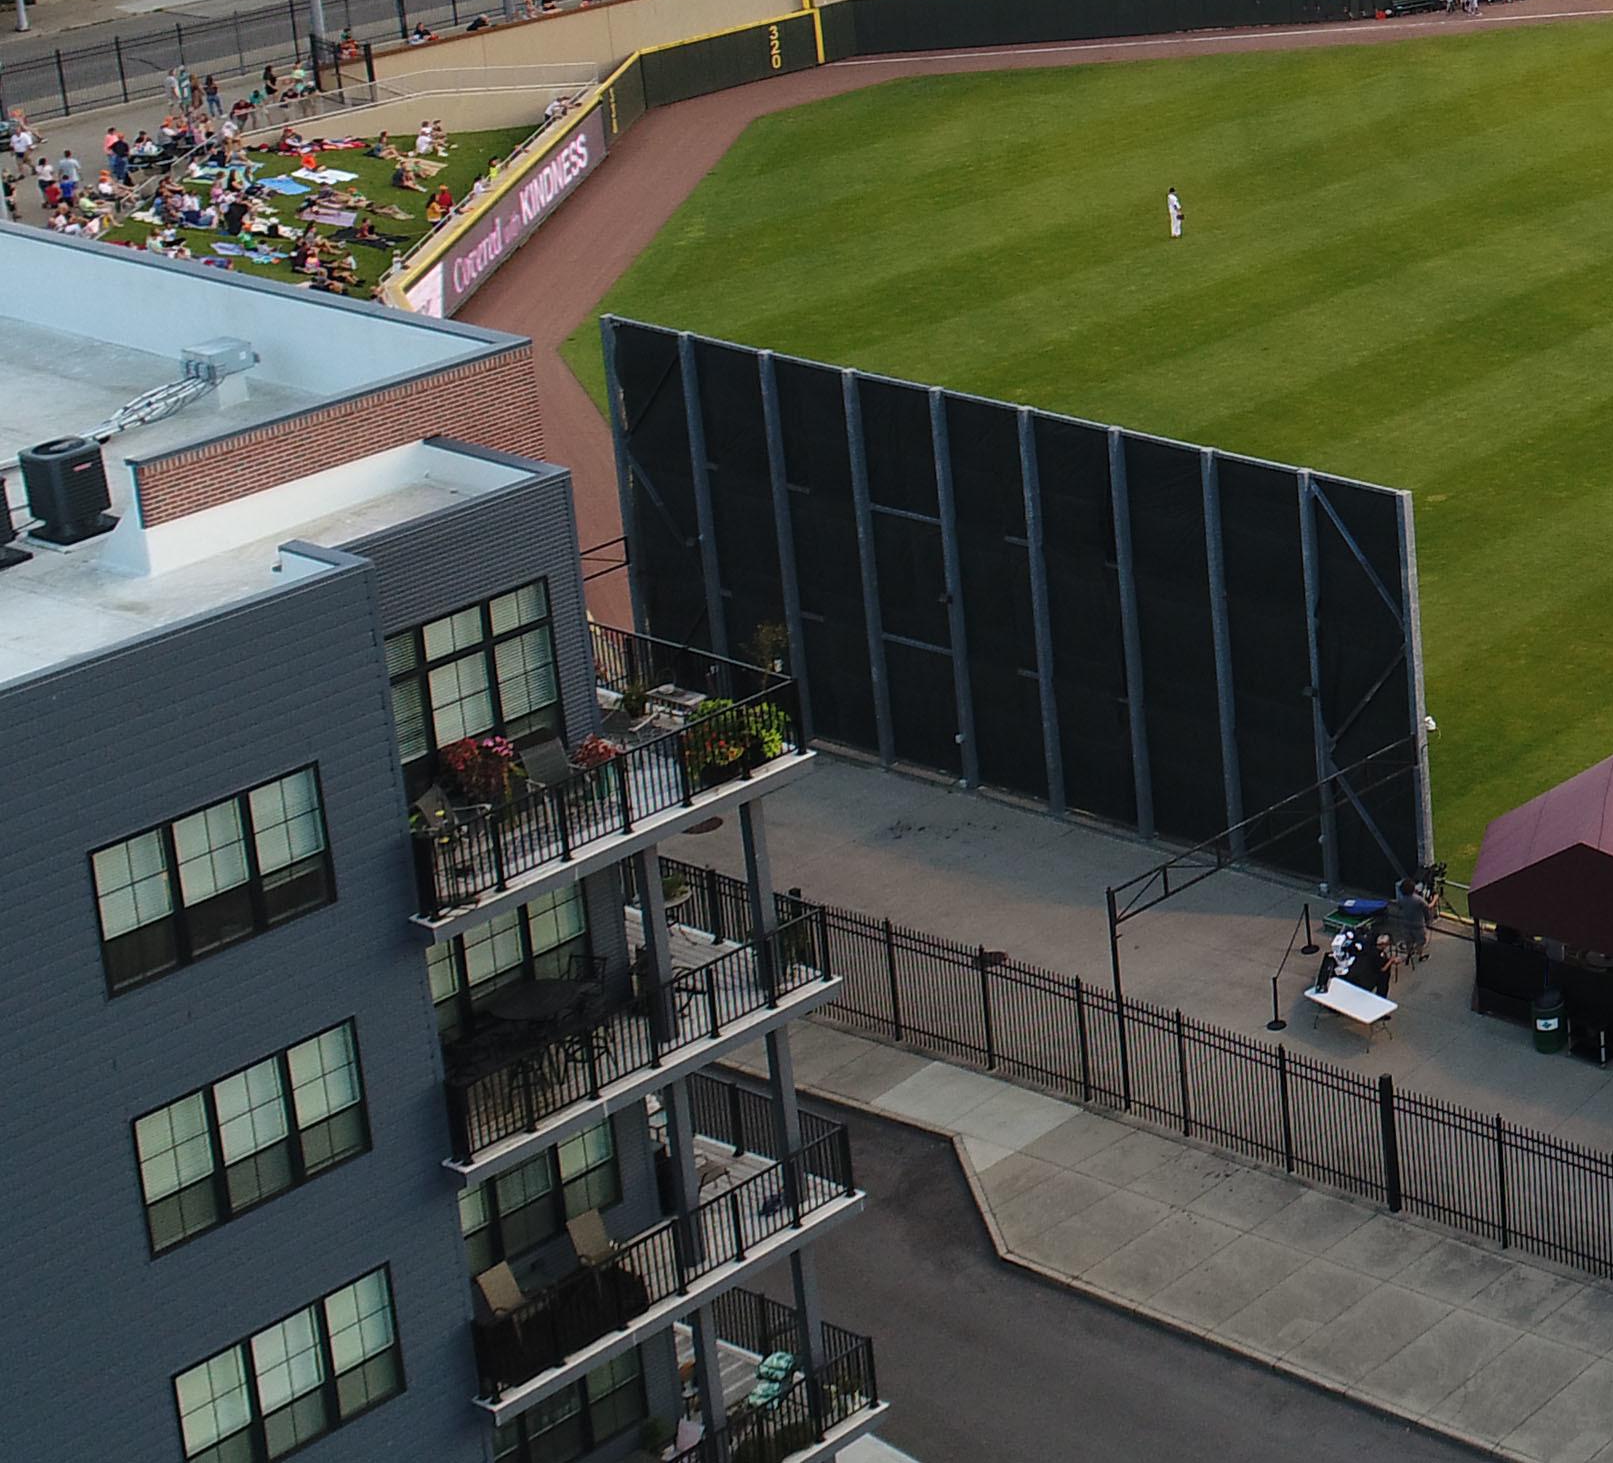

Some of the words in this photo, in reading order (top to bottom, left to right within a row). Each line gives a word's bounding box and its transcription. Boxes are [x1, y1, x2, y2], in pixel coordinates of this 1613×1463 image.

[768, 24, 783, 70] 320
[451, 217, 503, 295] Covered
[518, 132, 590, 226] KINDNESS
